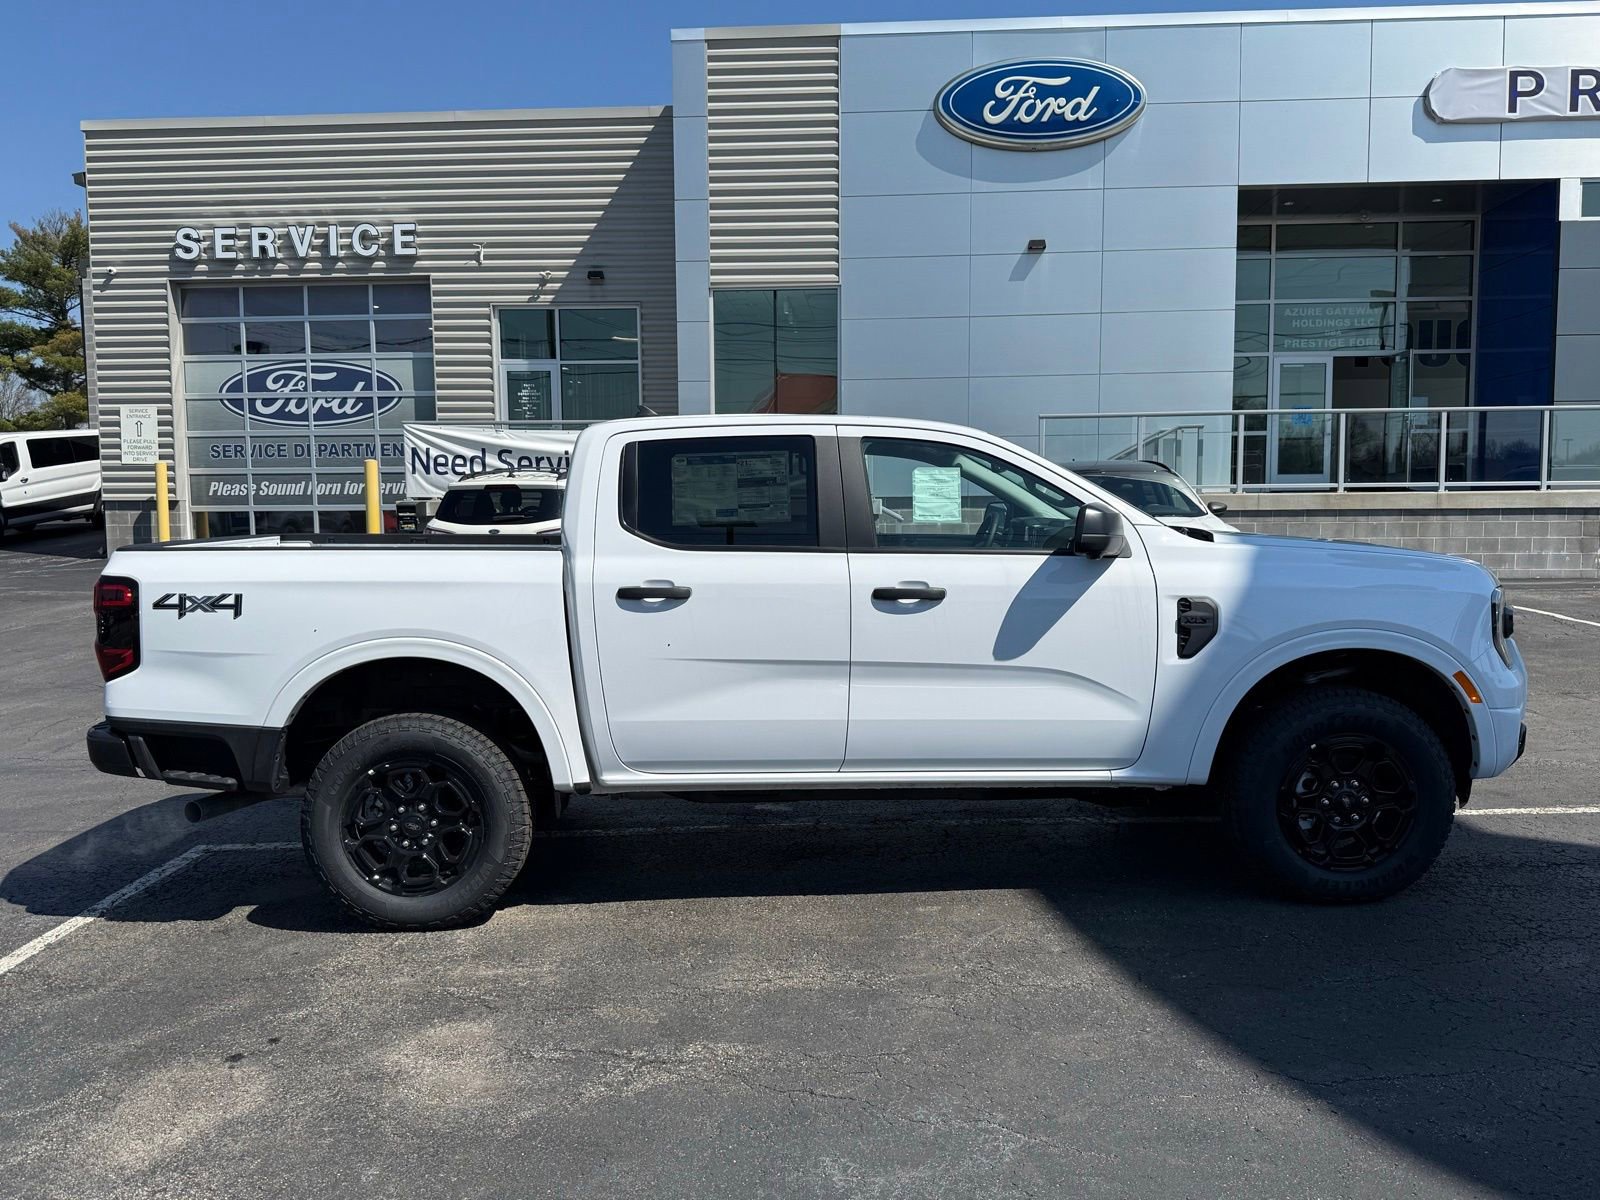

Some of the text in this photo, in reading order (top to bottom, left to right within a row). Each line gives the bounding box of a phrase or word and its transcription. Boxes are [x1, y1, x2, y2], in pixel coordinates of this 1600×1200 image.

[983, 76, 1101, 125] Ford
[174, 223, 418, 260] SERVICE
[1284, 307, 1322, 317] AZURE
[1292, 317, 1375, 329] HOLDINGS LLC
[1284, 338, 1346, 348] PRESTIGE
[255, 370, 366, 415] Ford
[210, 442, 405, 459] SERVICE DEPARTMEN
[411, 447, 570, 475] Need Servi
[209, 481, 257, 496] Please
[259, 481, 306, 496] Sound
[344, 480, 366, 495] for
[380, 480, 407, 495] ervi
